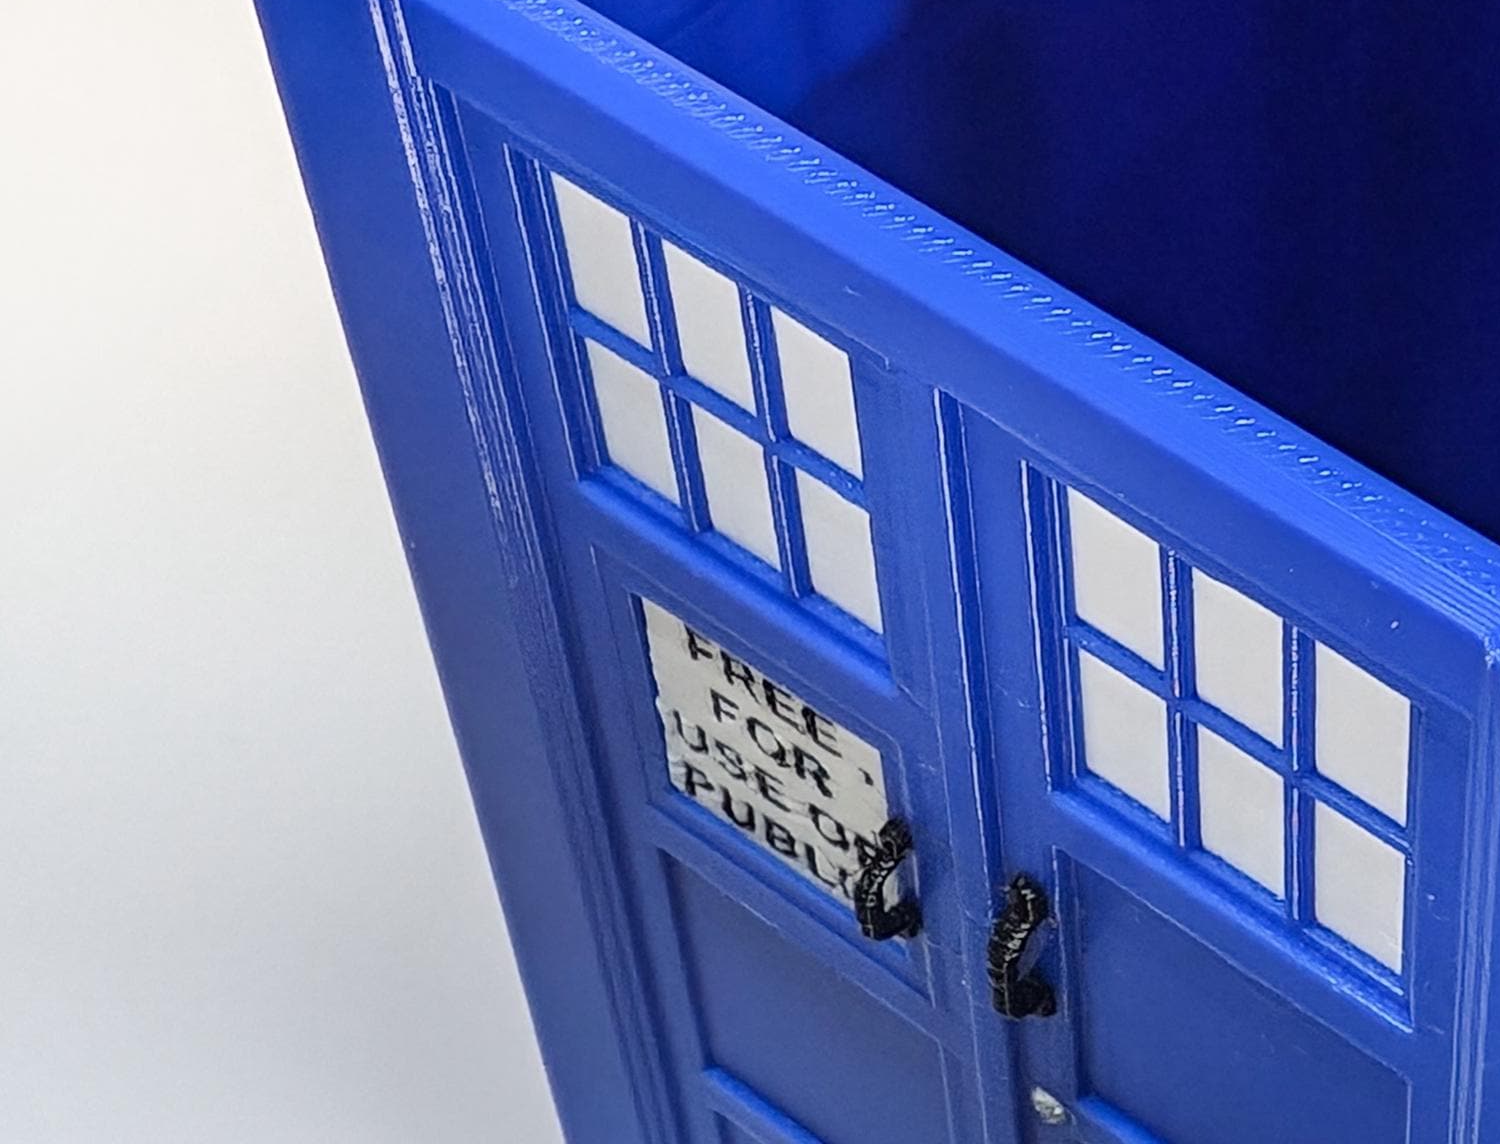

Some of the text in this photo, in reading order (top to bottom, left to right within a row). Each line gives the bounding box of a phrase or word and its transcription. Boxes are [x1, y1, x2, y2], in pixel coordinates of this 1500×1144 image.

[684, 623, 842, 758] FREE
[710, 688, 833, 799] FOR
[674, 709, 792, 813] USE
